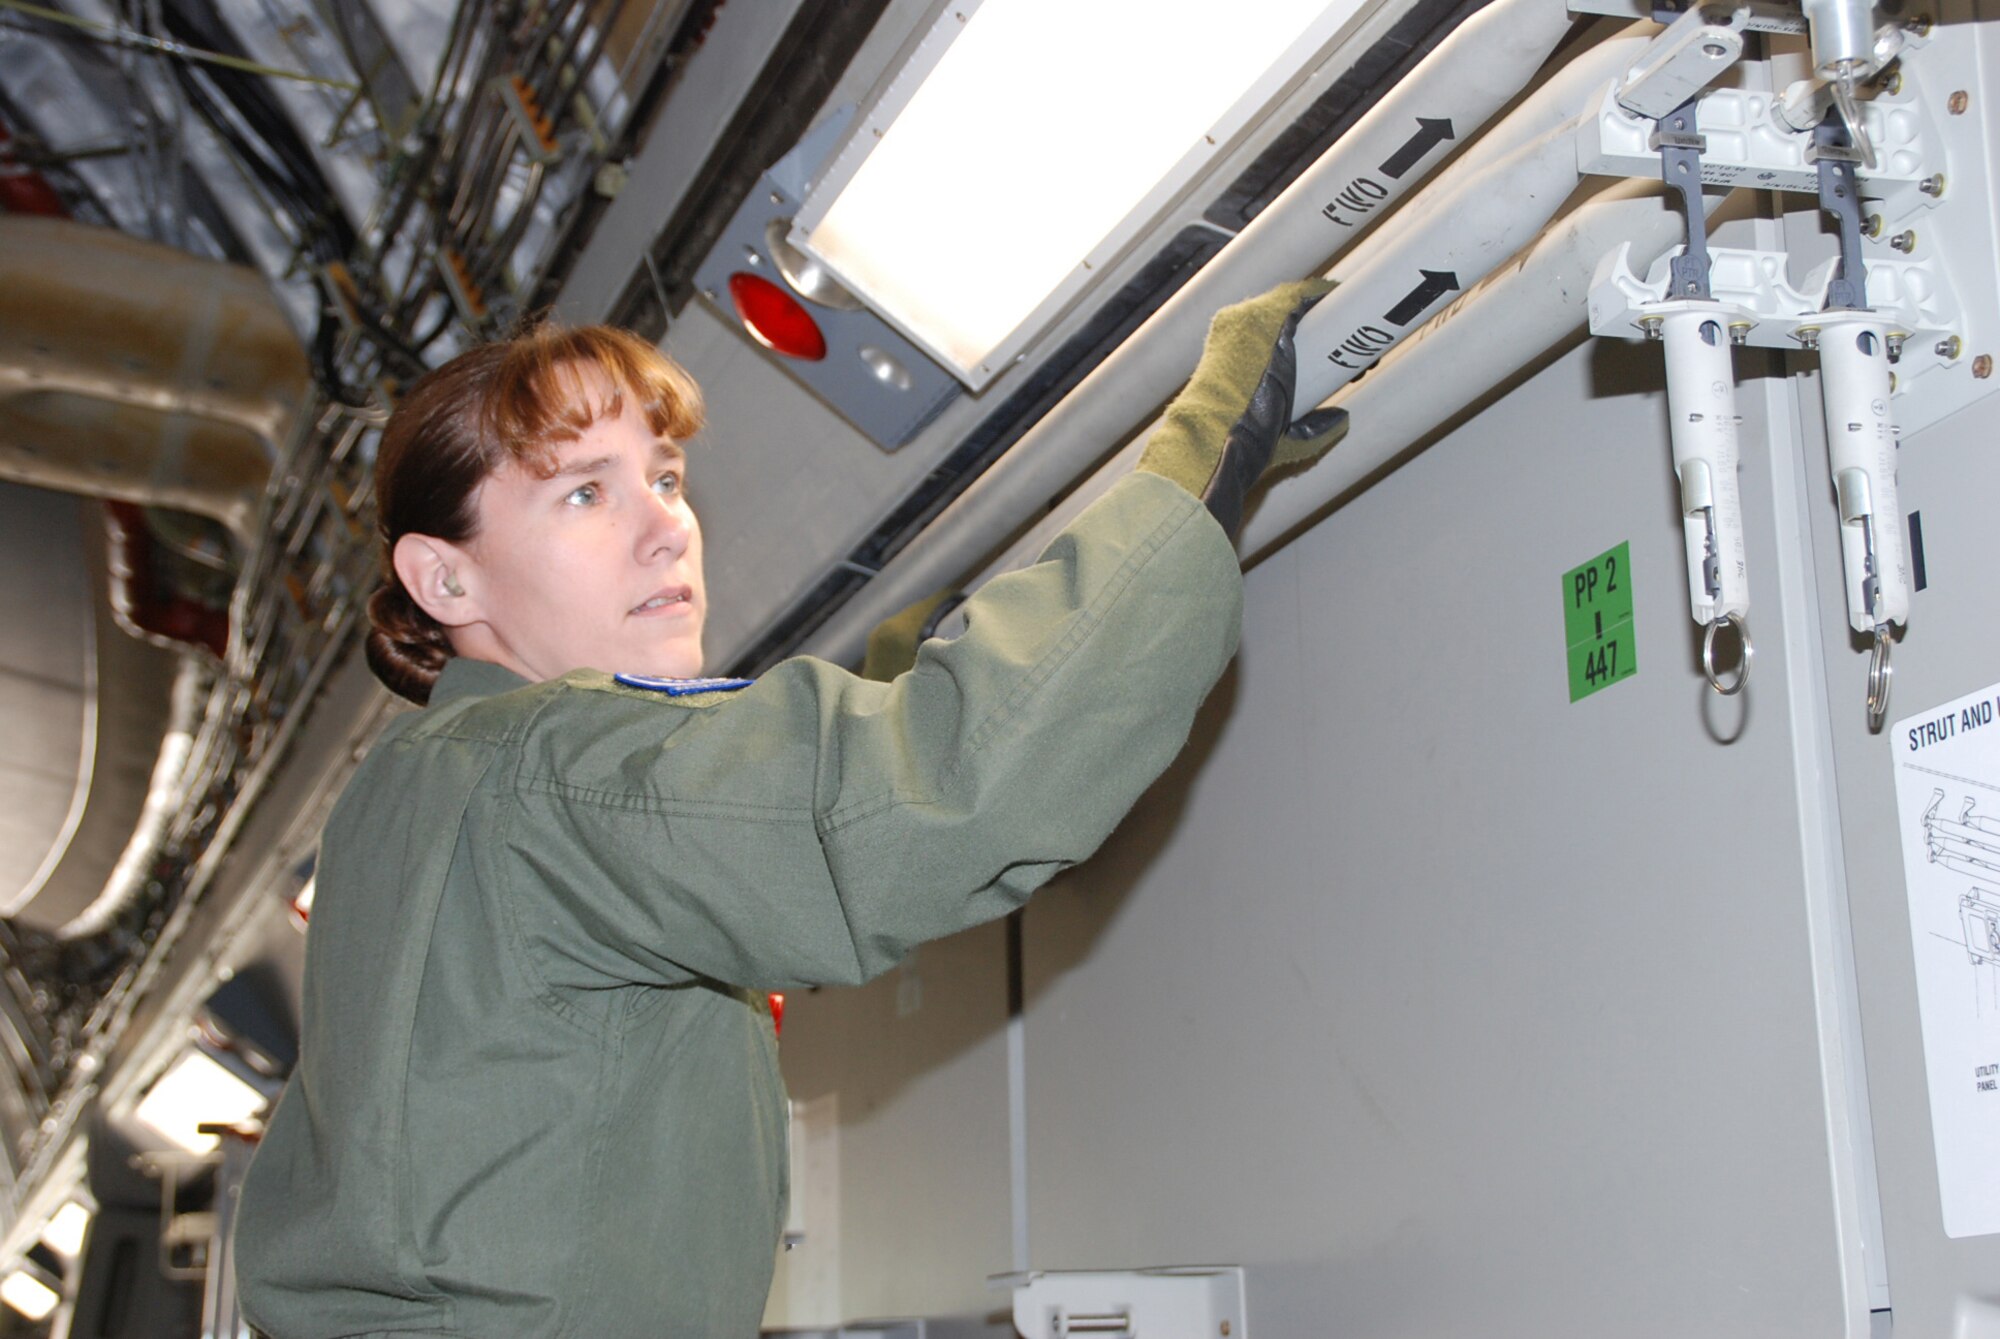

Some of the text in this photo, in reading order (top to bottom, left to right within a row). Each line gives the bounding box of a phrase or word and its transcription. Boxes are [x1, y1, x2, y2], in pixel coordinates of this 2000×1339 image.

[1574, 556, 1617, 609] PP 2
[1585, 638, 1617, 687] 447
[1908, 713, 1956, 751] STRUT
[1961, 700, 1992, 733] AND
[1974, 1063, 1999, 1078] UTILITY
[1976, 1079, 1998, 1093] PANEL
